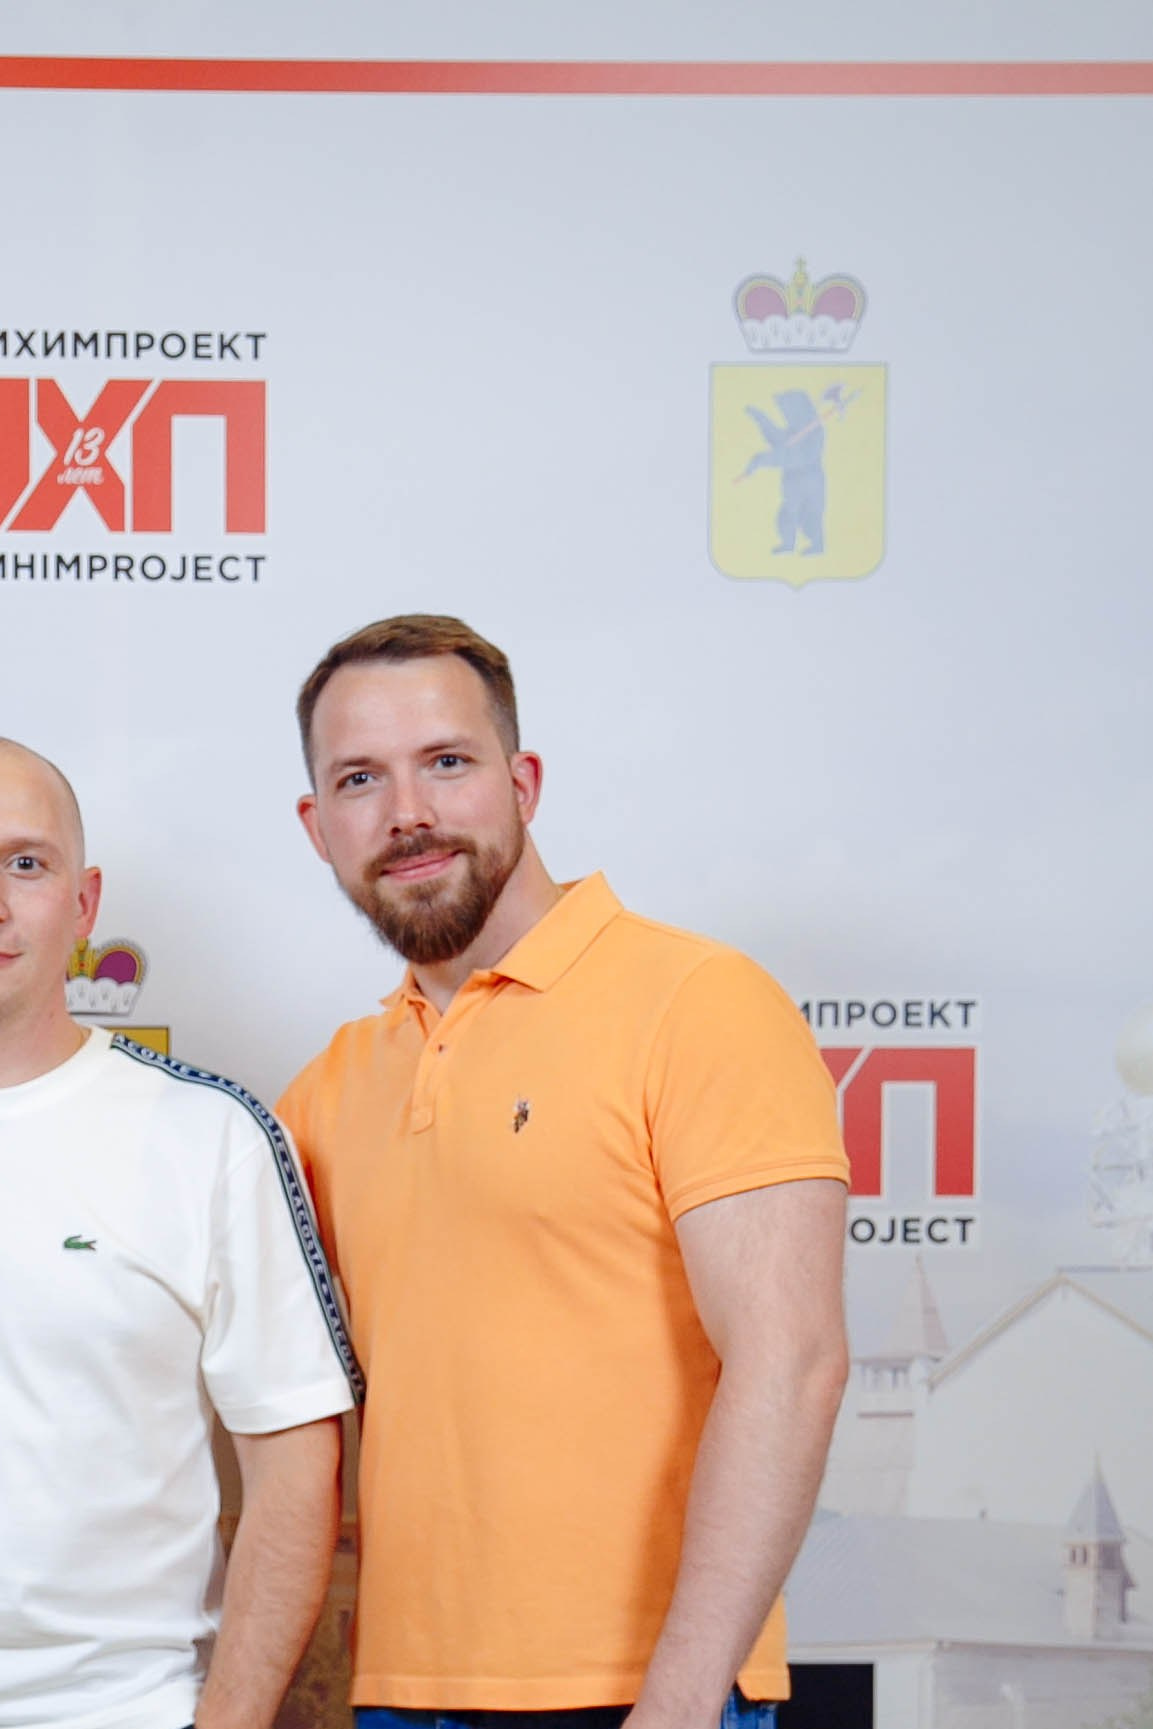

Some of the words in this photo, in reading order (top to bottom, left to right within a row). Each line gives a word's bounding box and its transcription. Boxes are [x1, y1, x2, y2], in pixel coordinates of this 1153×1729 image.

[62, 426, 105, 467] 13
[799, 1000, 977, 1029] ПРОЕКТ
[114, 1033, 194, 1077] ACOSTE
[850, 1216, 975, 1244] OJECT
